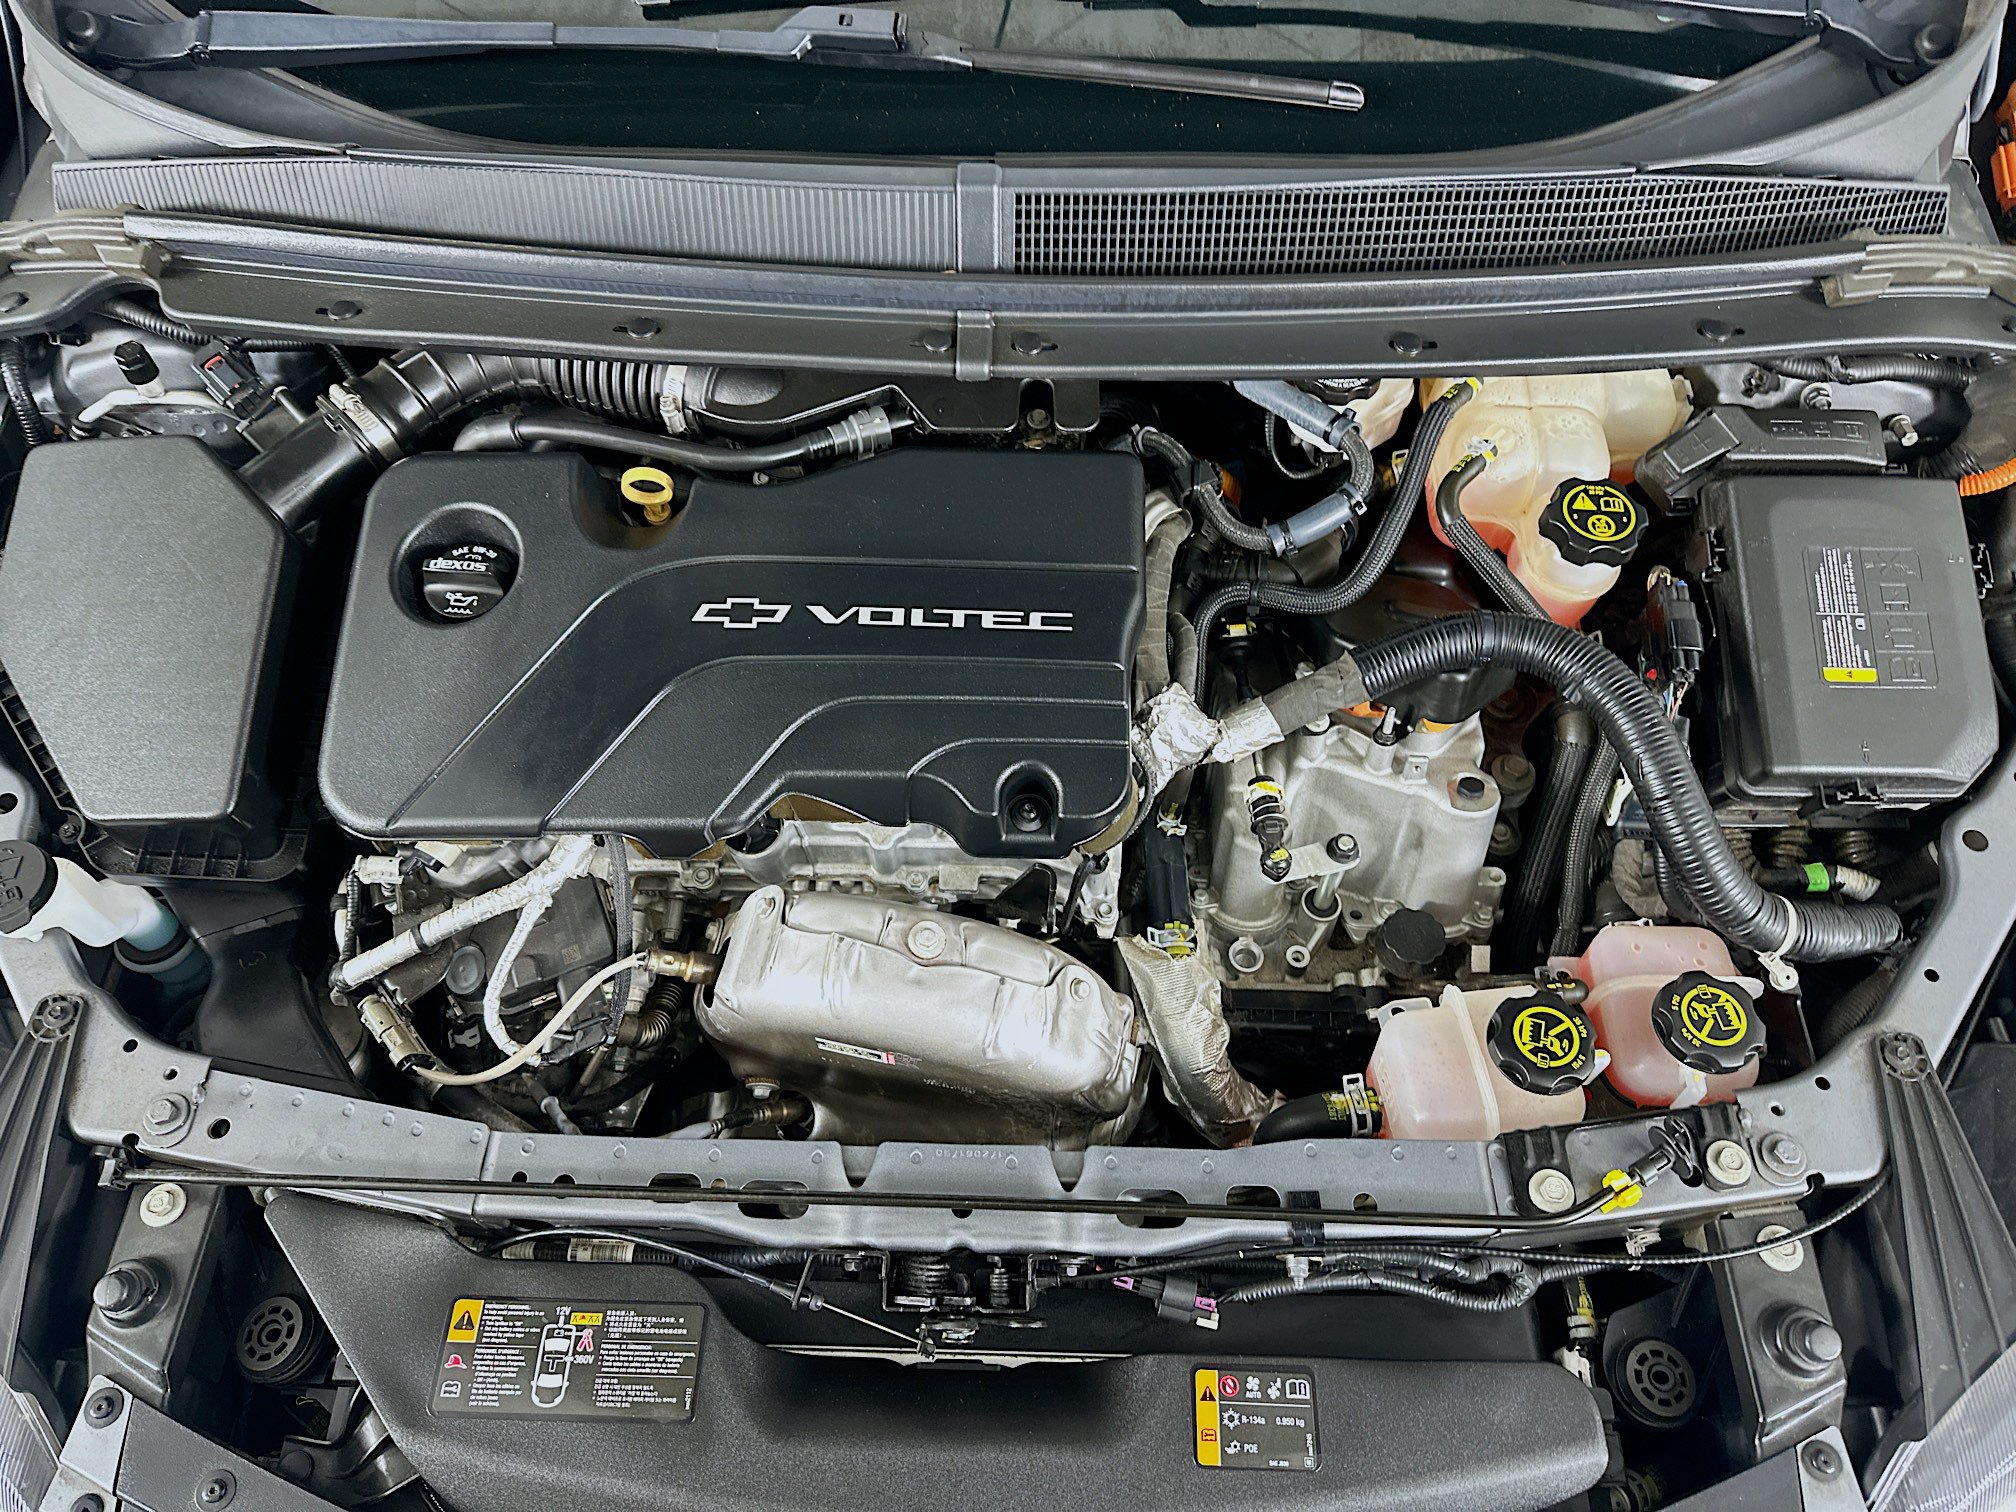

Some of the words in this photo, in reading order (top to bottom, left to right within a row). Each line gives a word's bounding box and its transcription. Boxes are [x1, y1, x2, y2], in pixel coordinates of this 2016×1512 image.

[452, 546, 469, 556] SAE
[429, 557, 489, 572] dexos
[806, 605, 1074, 631] VOLTEC
[1672, 994, 1681, 1005] PSI
[1571, 1058, 1583, 1070] PSI
[555, 1306, 571, 1316] 12V
[573, 1355, 594, 1365] 360V
[1241, 1415, 1266, 1425] R-134a
[1276, 1417, 1294, 1426] 0.950
[1296, 1418, 1305, 1428] kg
[1244, 1444, 1258, 1453] POE
